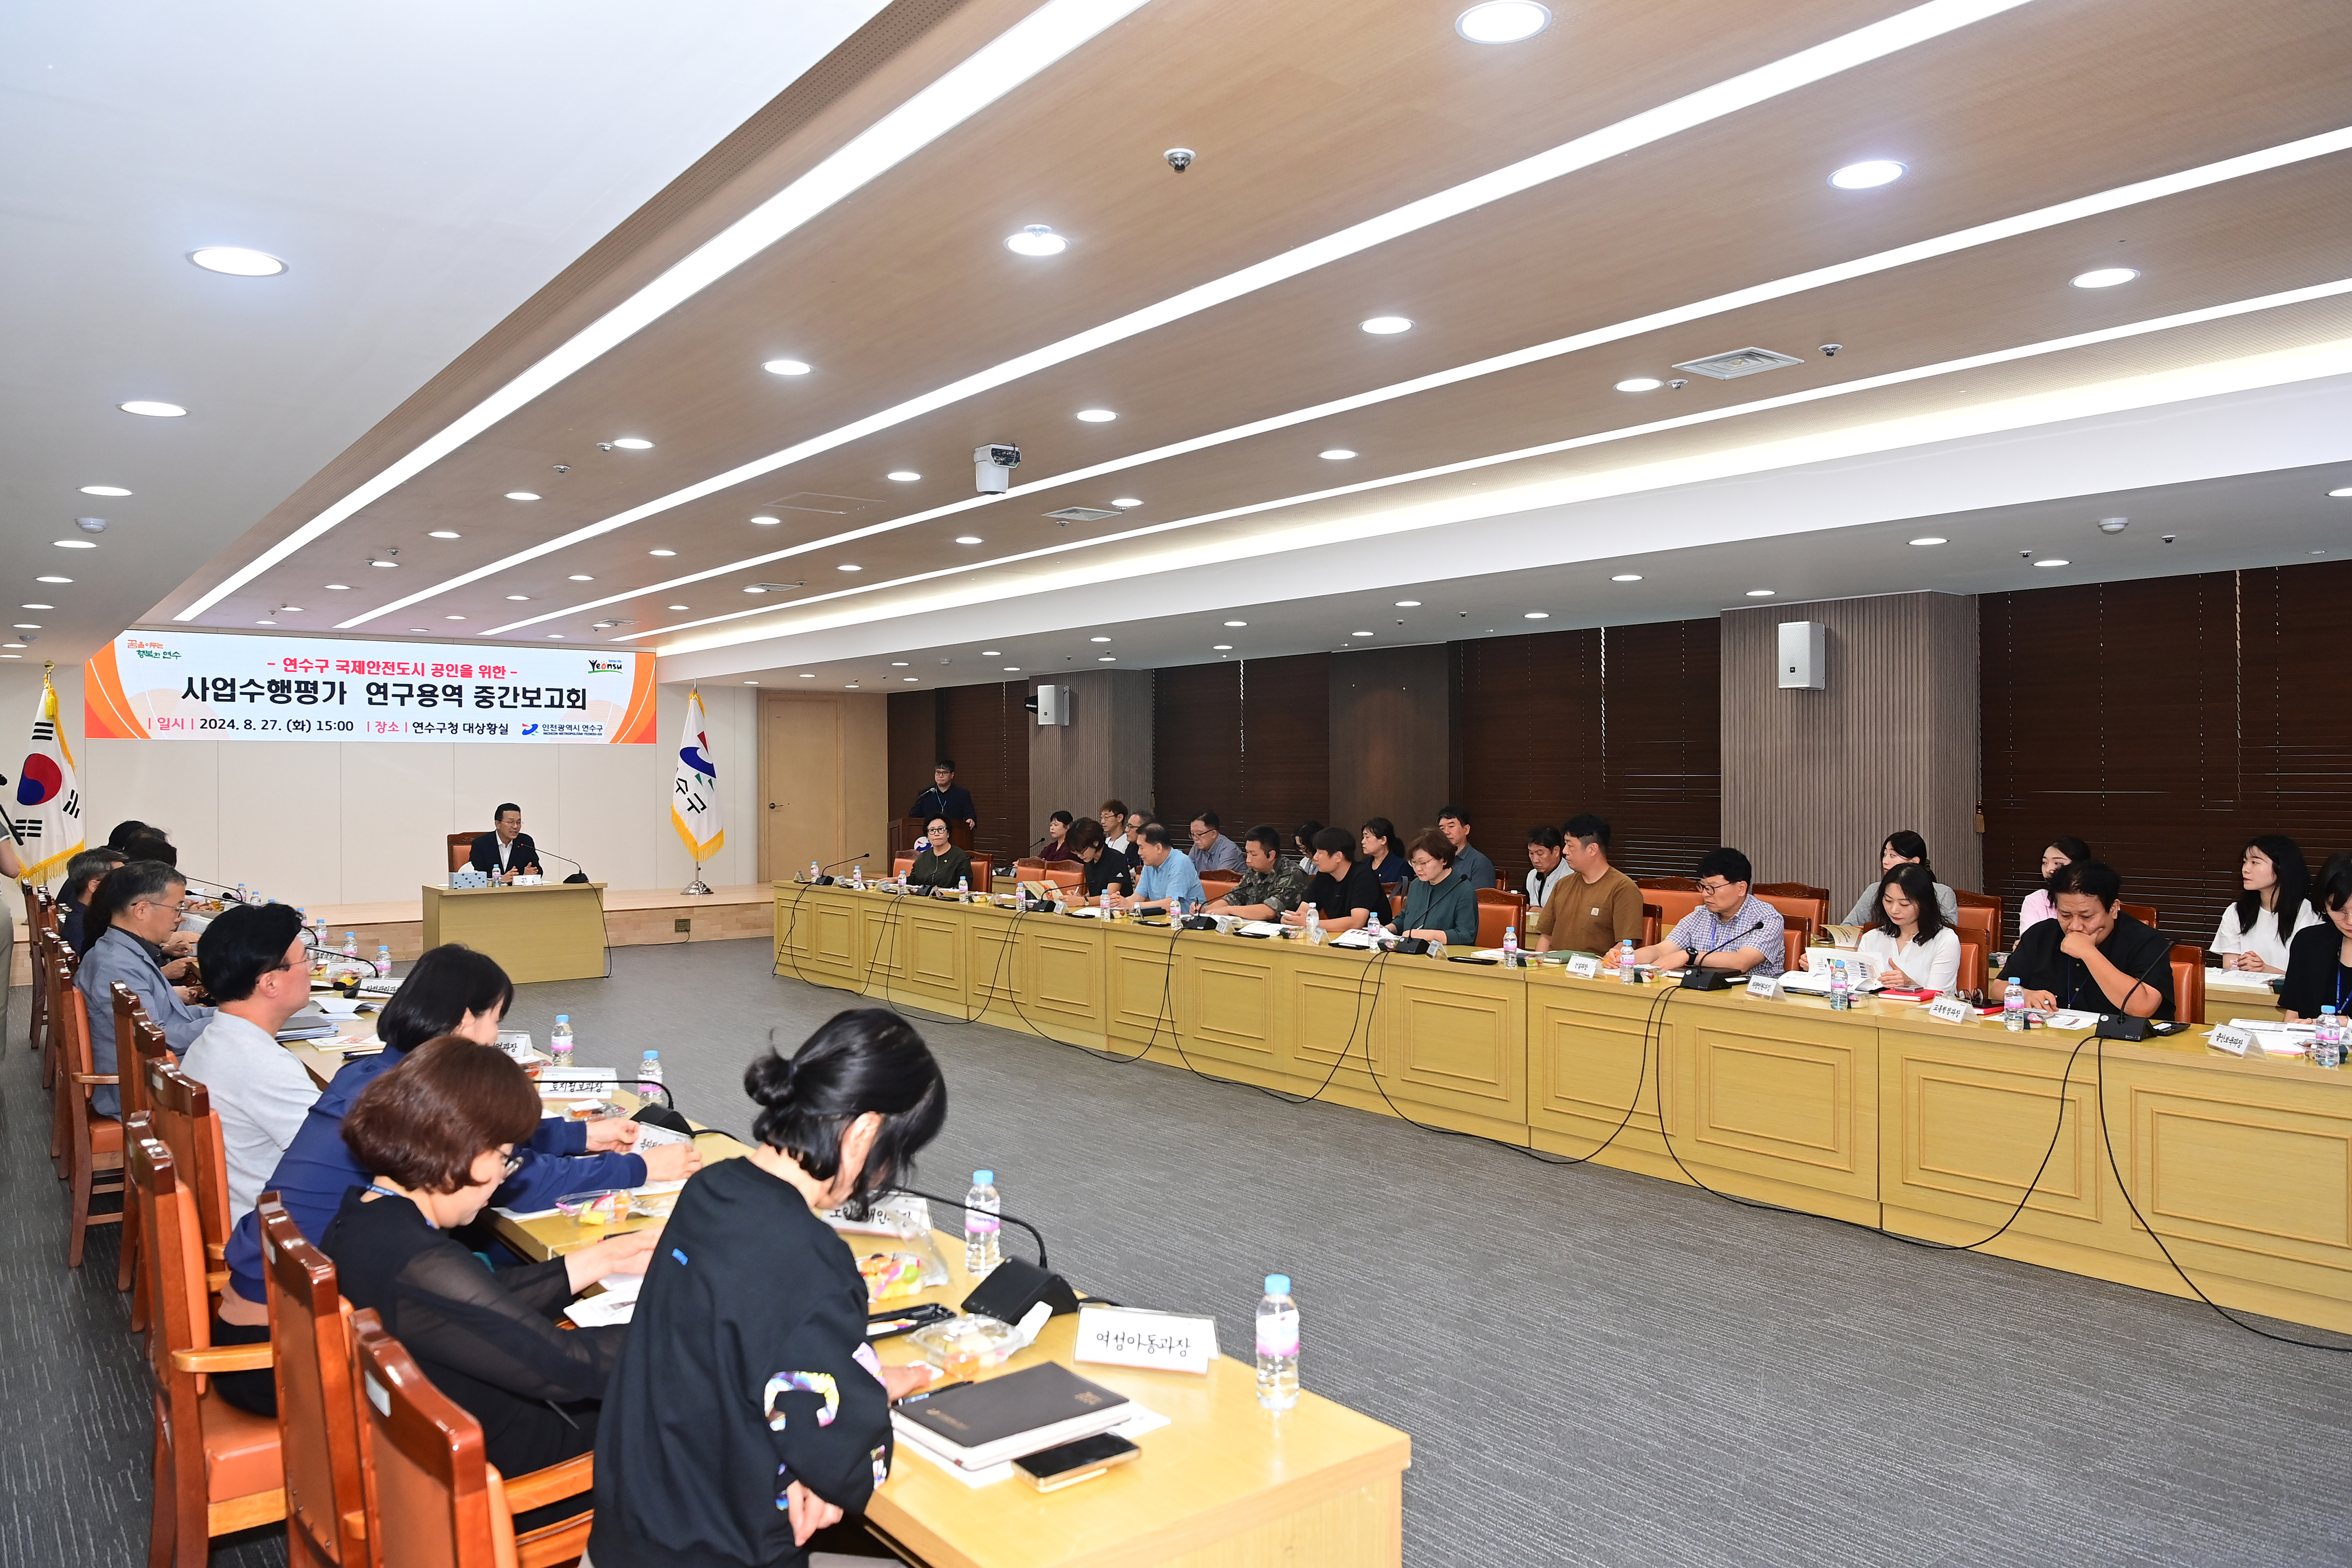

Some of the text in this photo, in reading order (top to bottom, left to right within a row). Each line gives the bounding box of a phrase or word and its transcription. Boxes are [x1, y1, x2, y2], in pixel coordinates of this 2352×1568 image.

[136, 650, 182, 660] 행복한 연수
[283, 657, 329, 674] 연수구
[336, 659, 425, 677] 국제안전도시
[431, 663, 473, 678] 공인을
[478, 664, 506, 679] 위한
[588, 659, 622, 672] Yeonsu
[181, 676, 586, 710] 사업수행평가 연구용역 중간보고회
[157, 717, 509, 735] 일시 2024. 8. 27. (화) 15:00 장소 연수구청 대상황실
[1096, 1330, 1191, 1357] 여성아동과장
